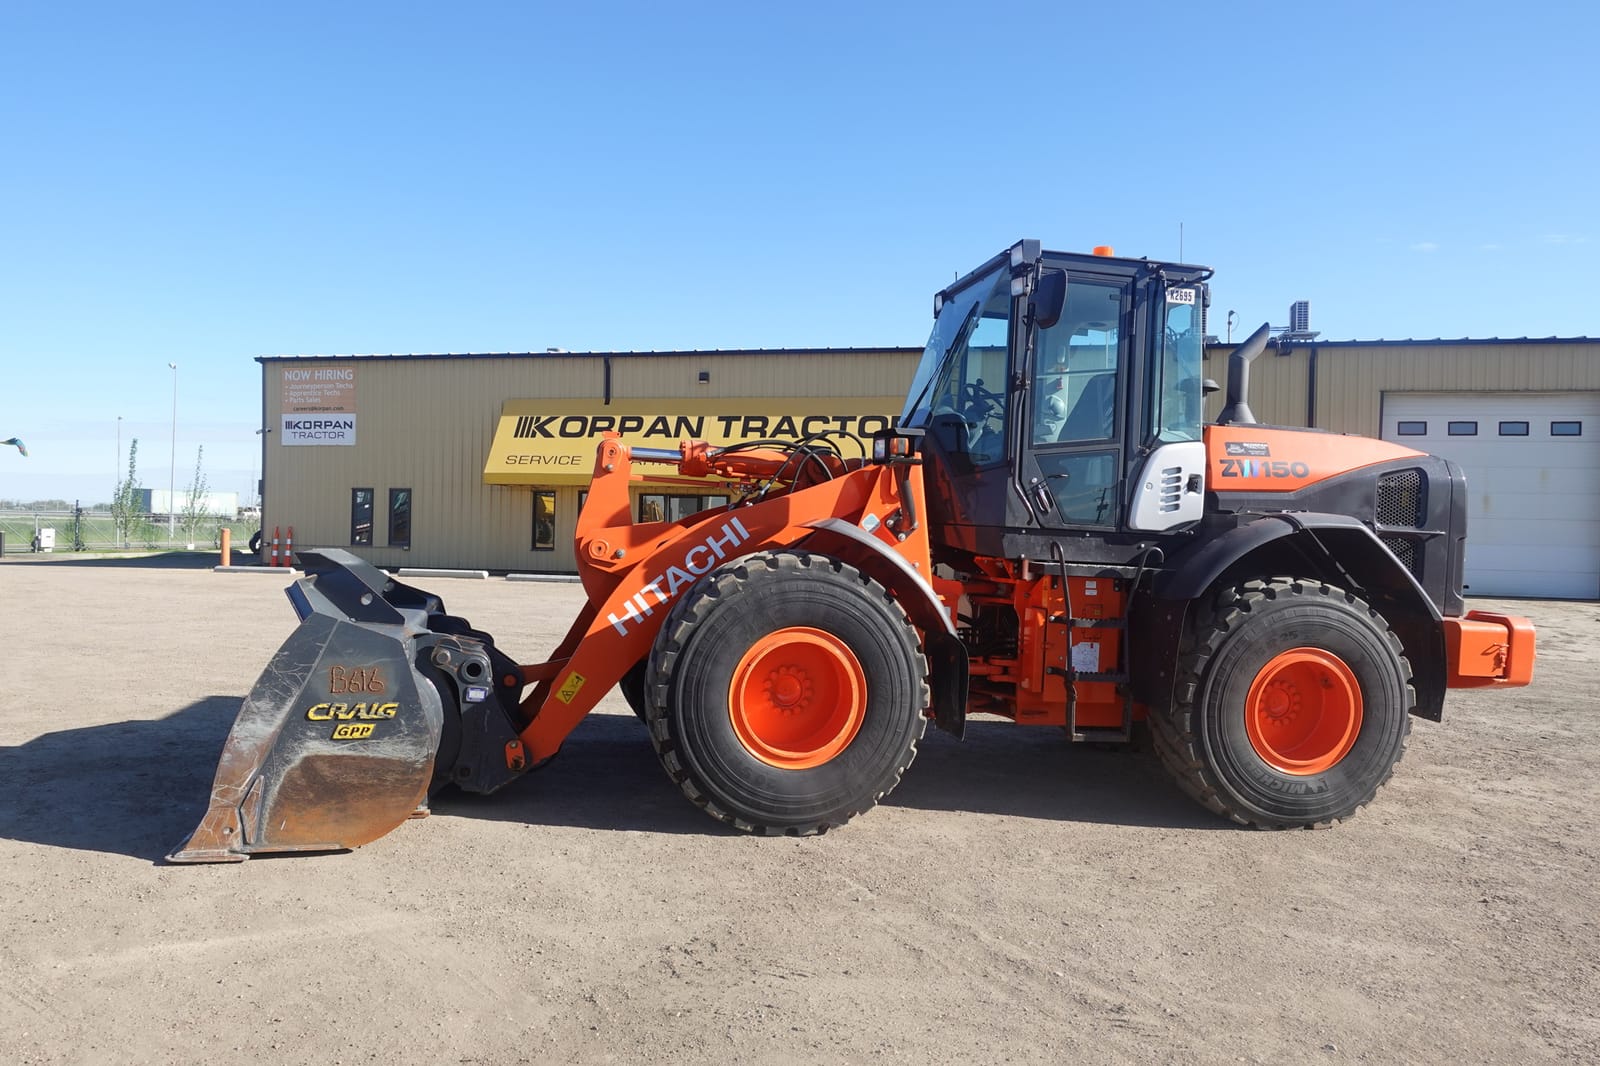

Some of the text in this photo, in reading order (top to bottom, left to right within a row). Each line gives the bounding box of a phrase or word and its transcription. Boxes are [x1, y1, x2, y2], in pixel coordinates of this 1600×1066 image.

[284, 369, 353, 381] NOW HIRING
[293, 420, 353, 430] KORPAN
[531, 415, 902, 439] KORPAN TRACTO
[291, 431, 345, 439] TRACTOR
[505, 455, 583, 465] SERVICE
[1219, 459, 1310, 478] ZW150
[607, 516, 751, 637] HITACHI
[330, 665, 385, 694] B616
[306, 702, 400, 721] CRAIG
[337, 726, 371, 737] GPP
